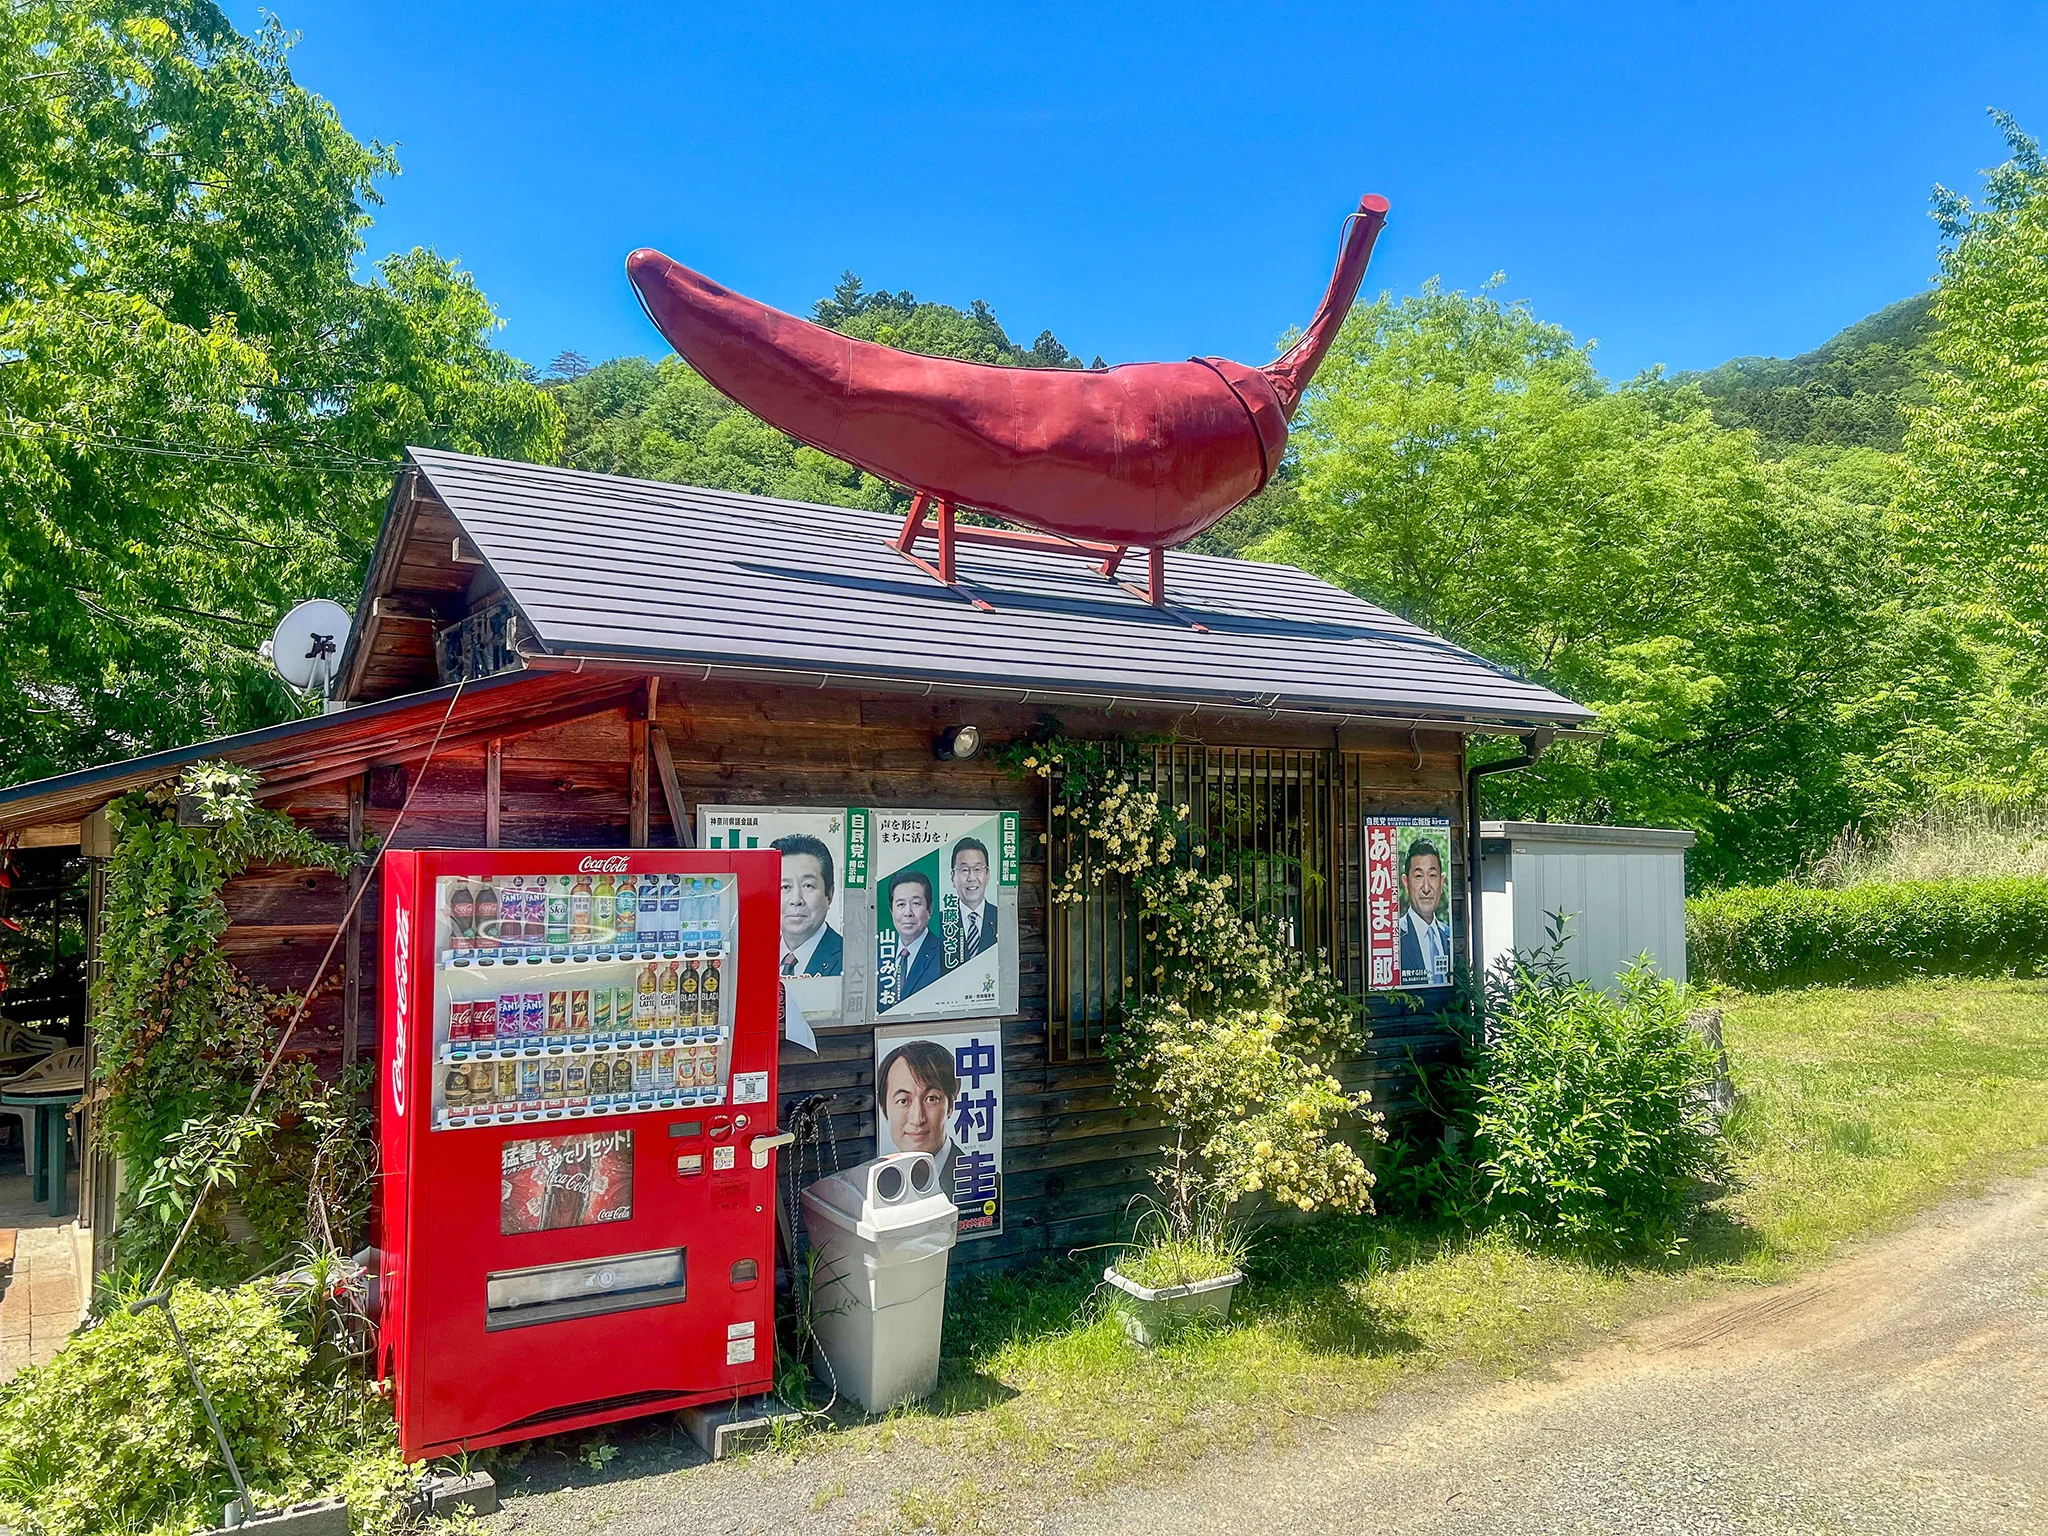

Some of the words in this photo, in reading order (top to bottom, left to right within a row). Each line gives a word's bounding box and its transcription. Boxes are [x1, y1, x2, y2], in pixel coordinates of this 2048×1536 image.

[850, 814, 865, 858] 自民党
[1003, 817, 1016, 858] 自民党
[1366, 817, 1386, 826] 自民党
[578, 855, 631, 873] Coca-Cola
[942, 893, 960, 969] 佐藤ひさし
[1369, 828, 1393, 986] あかま二郎
[878, 928, 897, 1006] 山口みつお
[392, 894, 409, 1117] Coca-Cola
[954, 1038, 998, 1205] 中村圭
[597, 1206, 631, 1222] Coca-Cola
